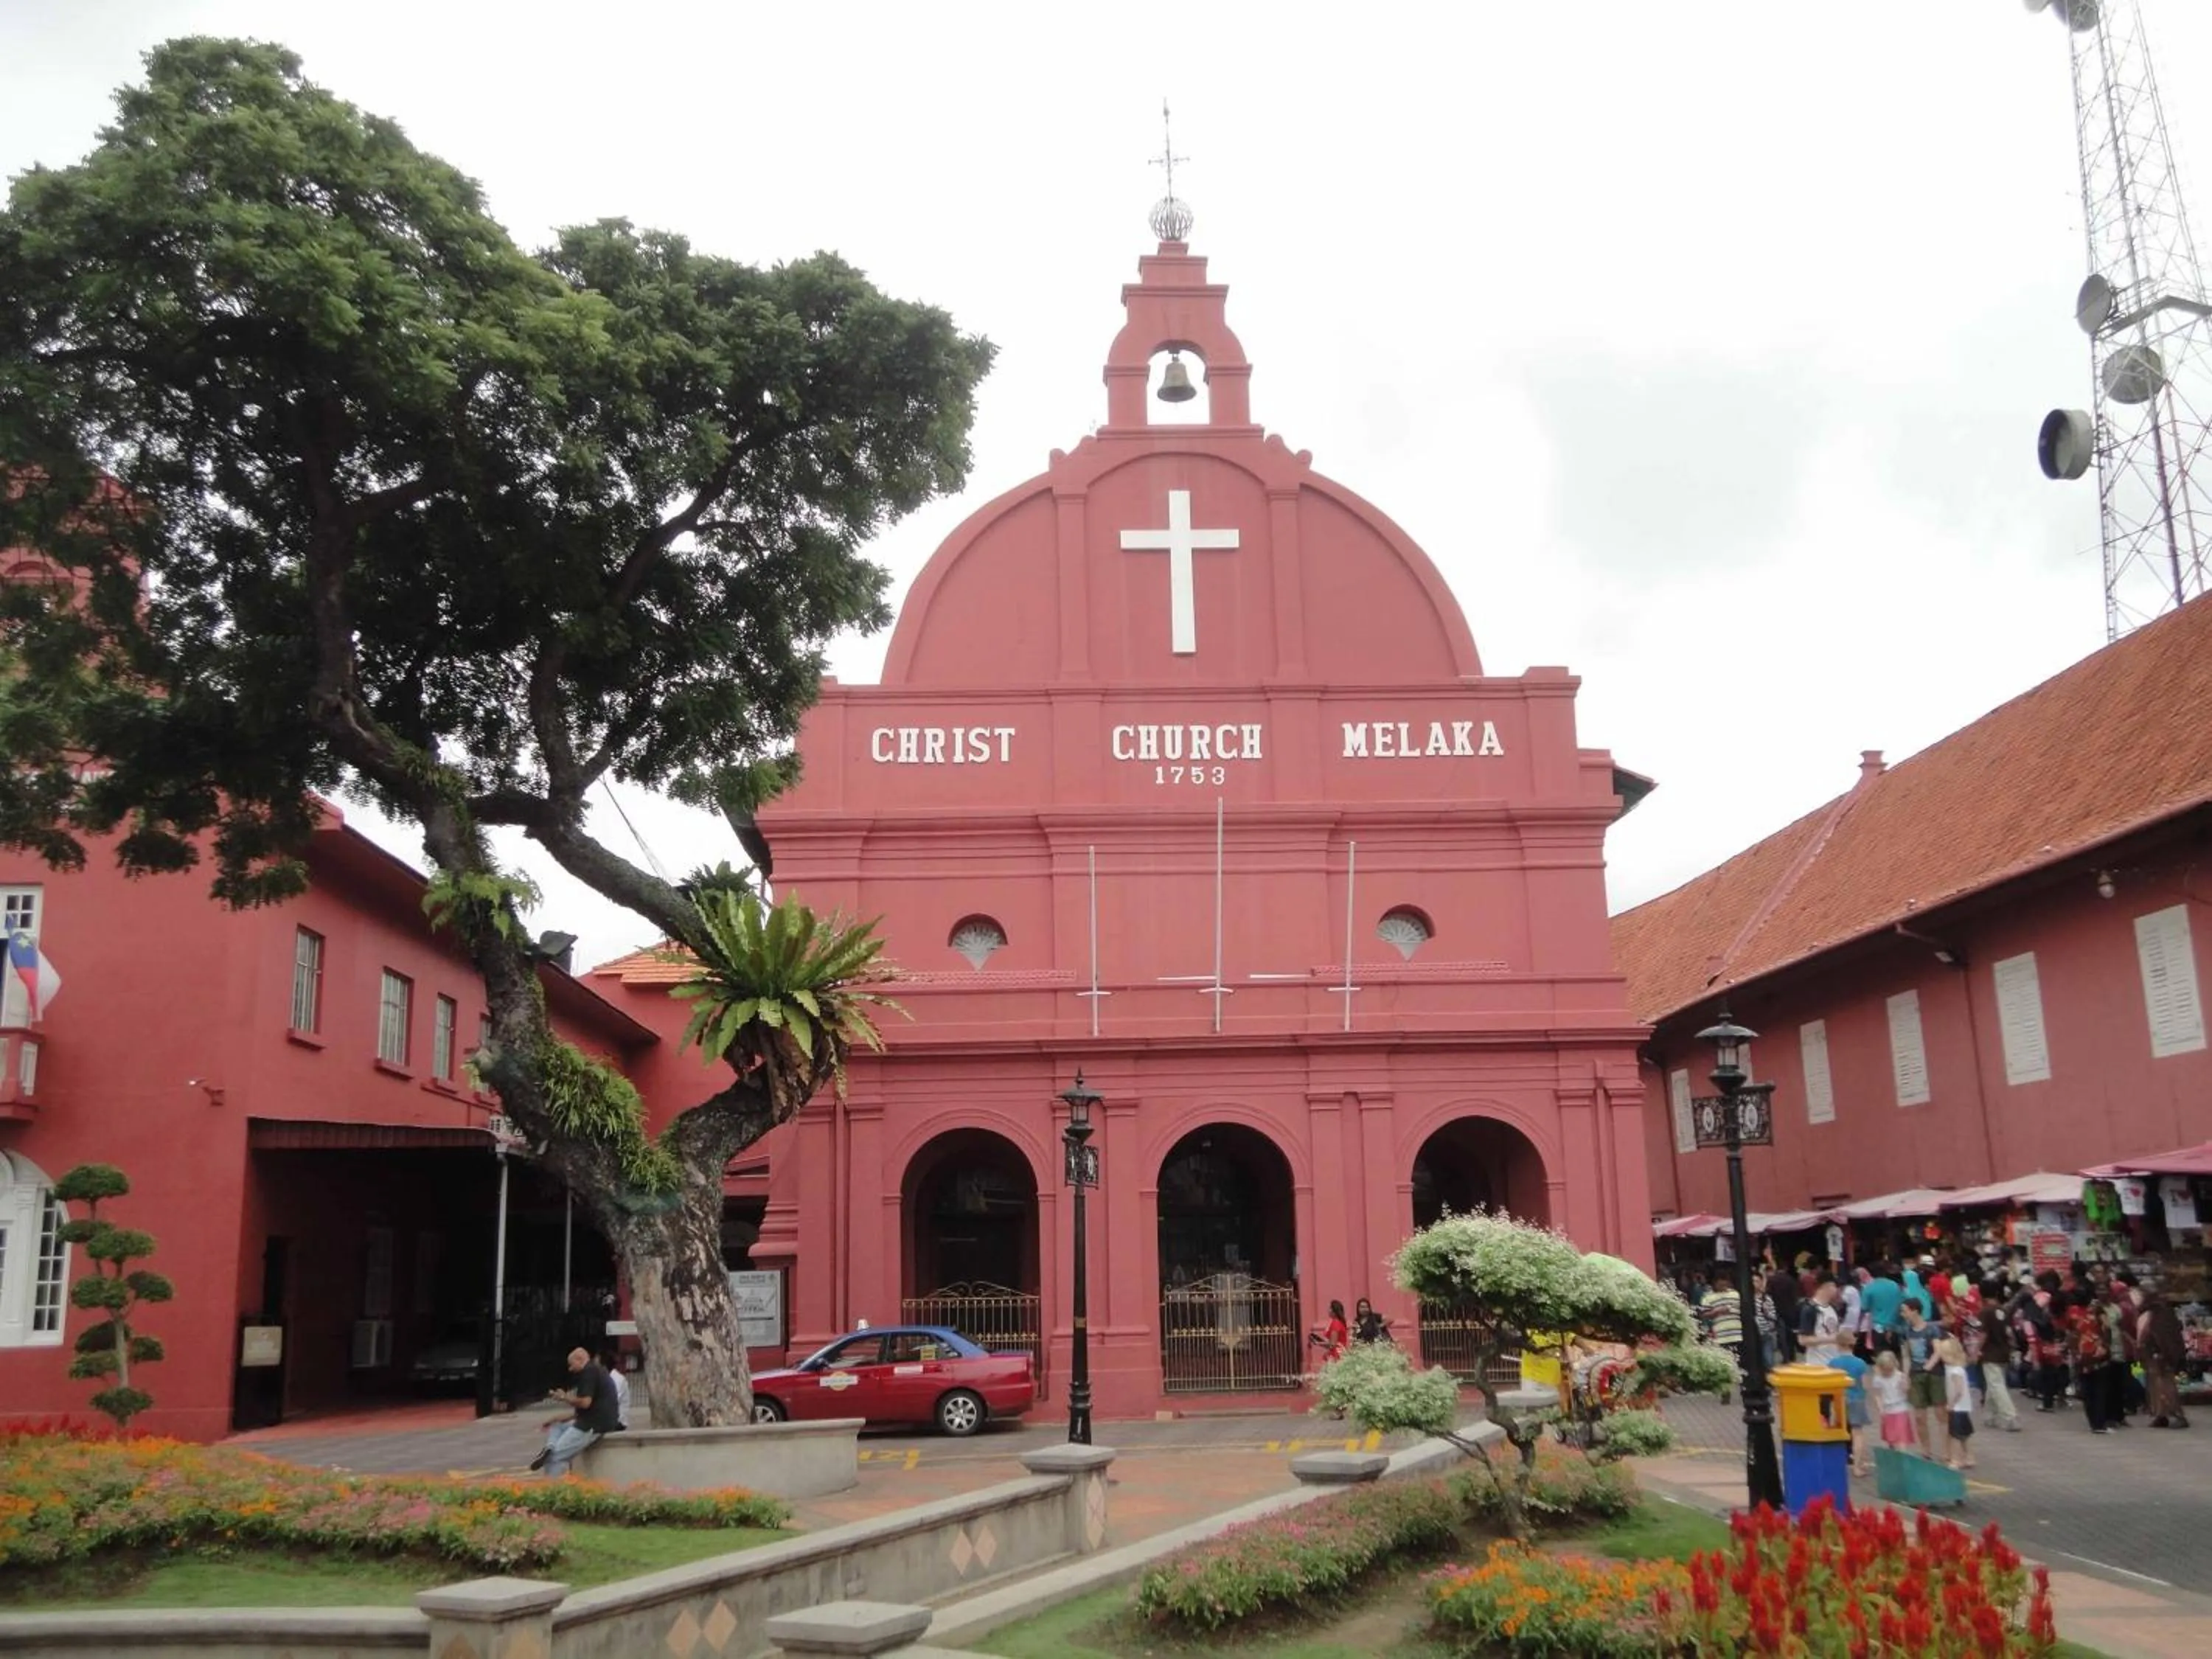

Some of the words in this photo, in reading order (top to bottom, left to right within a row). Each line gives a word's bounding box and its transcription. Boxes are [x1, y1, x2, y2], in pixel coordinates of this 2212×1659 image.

[871, 726, 1016, 764] CHRIST
[1112, 723, 1263, 761] CHURCH
[1341, 720, 1505, 758] MELAKA
[1155, 765, 1226, 786] 1753
